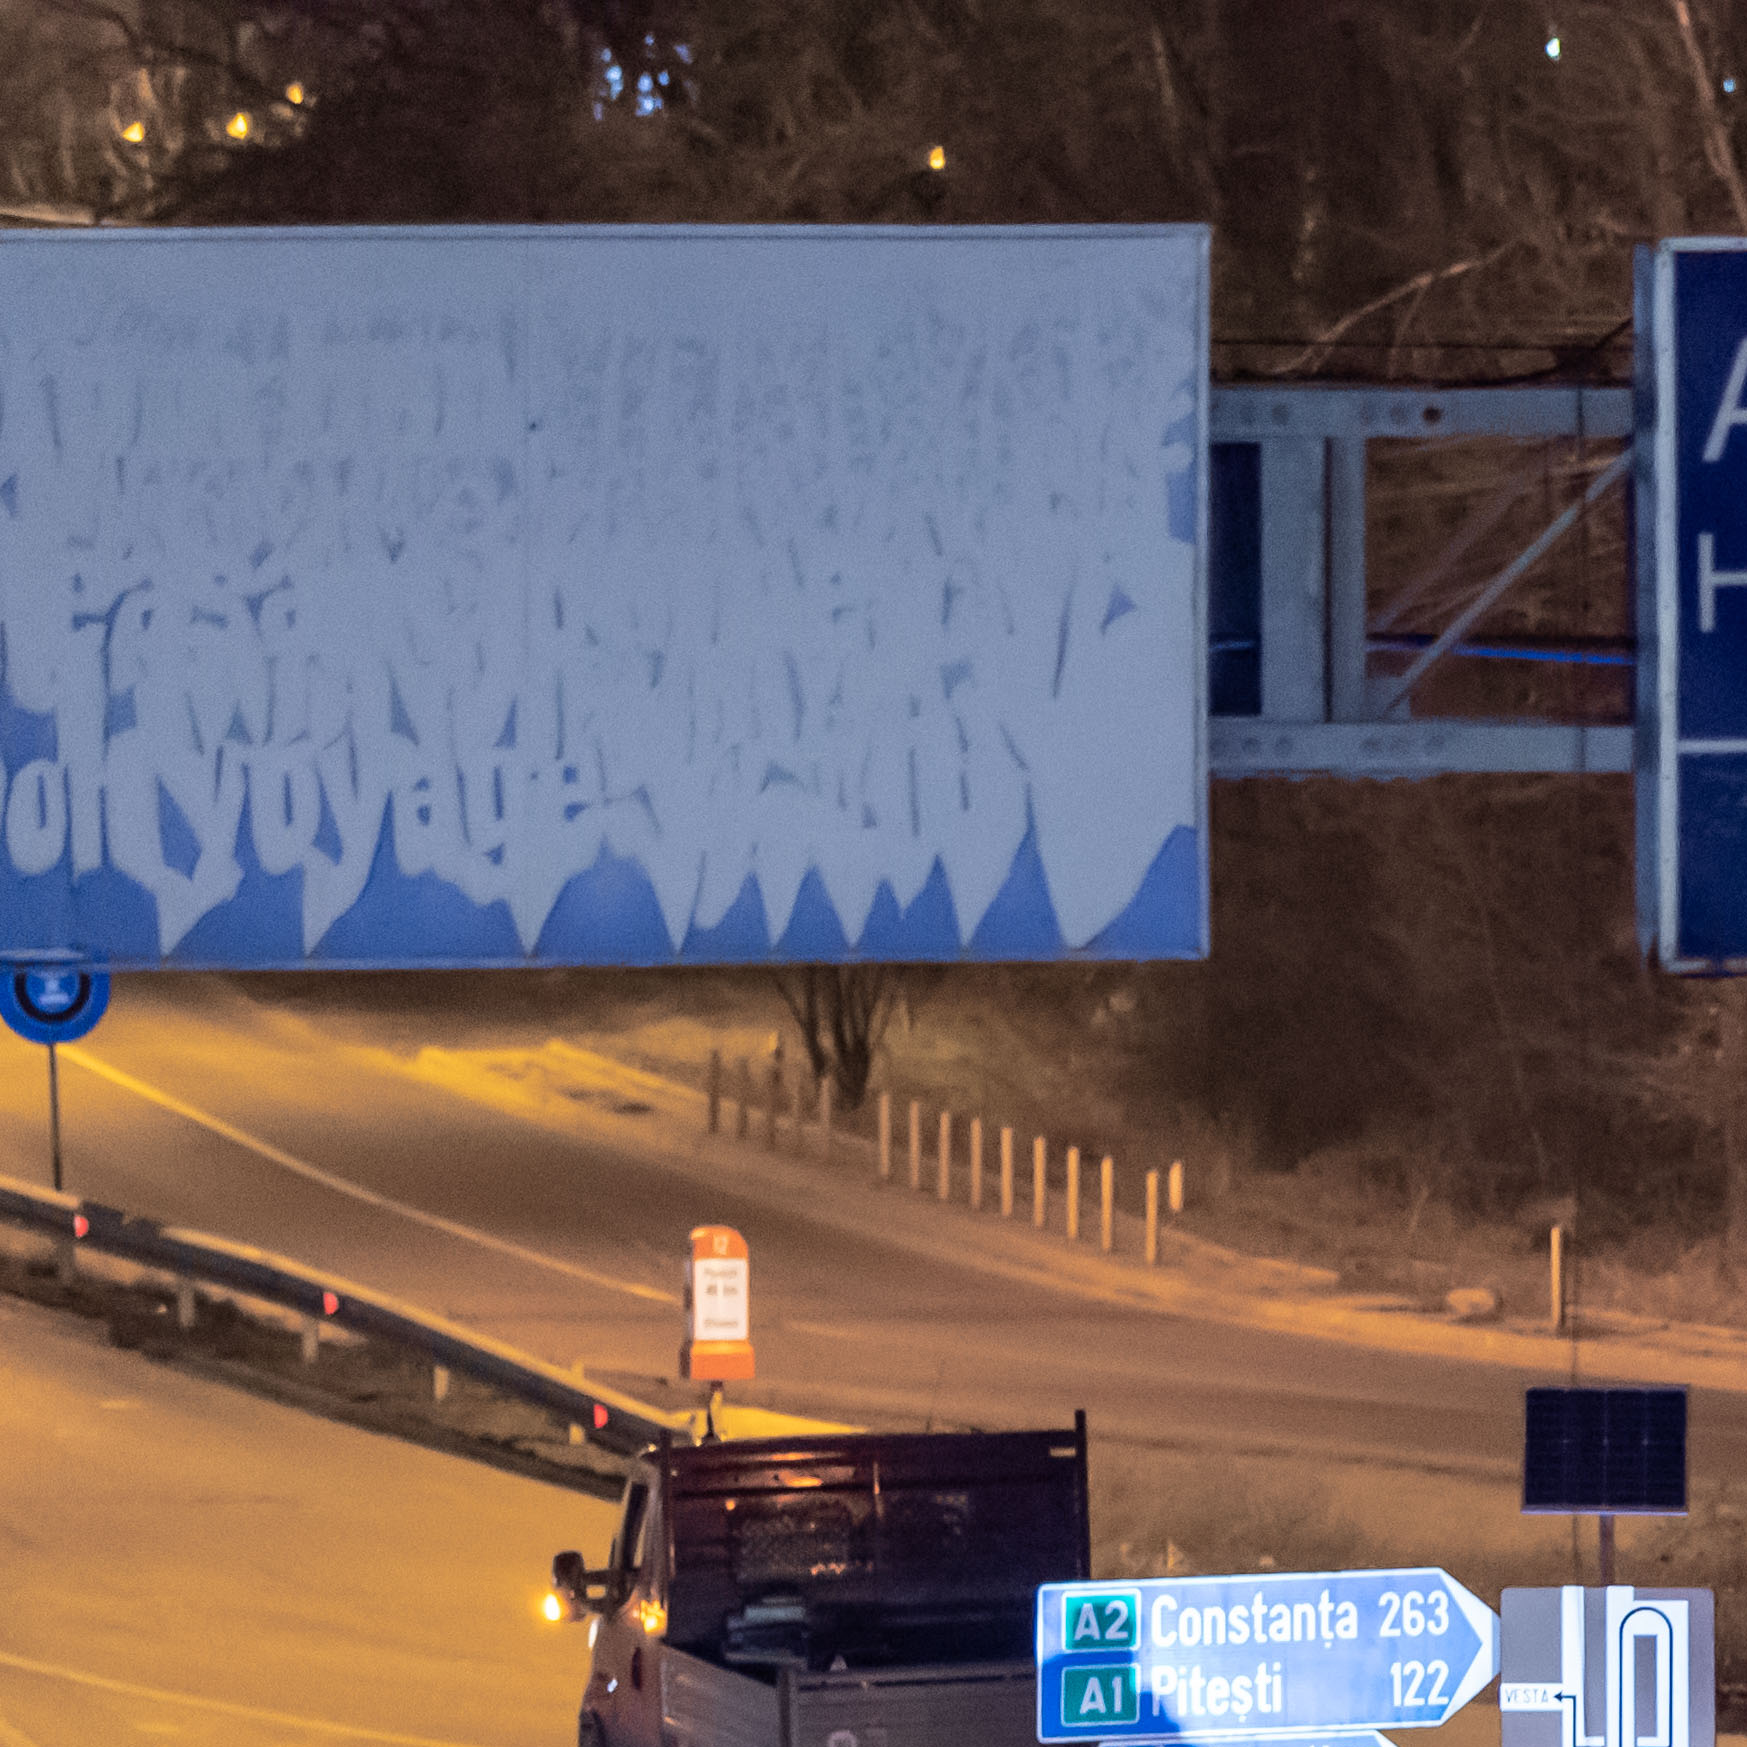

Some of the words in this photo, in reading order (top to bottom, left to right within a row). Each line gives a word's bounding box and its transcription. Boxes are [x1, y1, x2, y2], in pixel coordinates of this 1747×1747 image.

[1073, 1600, 1130, 1642] A2
[1150, 1588, 1359, 1650] Constanța
[1378, 1589, 1451, 1638] 263
[1079, 1670, 1124, 1715] A1
[1150, 1660, 1284, 1723] Pitești
[1389, 1660, 1451, 1708] 122
[1504, 1687, 1549, 1703] VESTA
